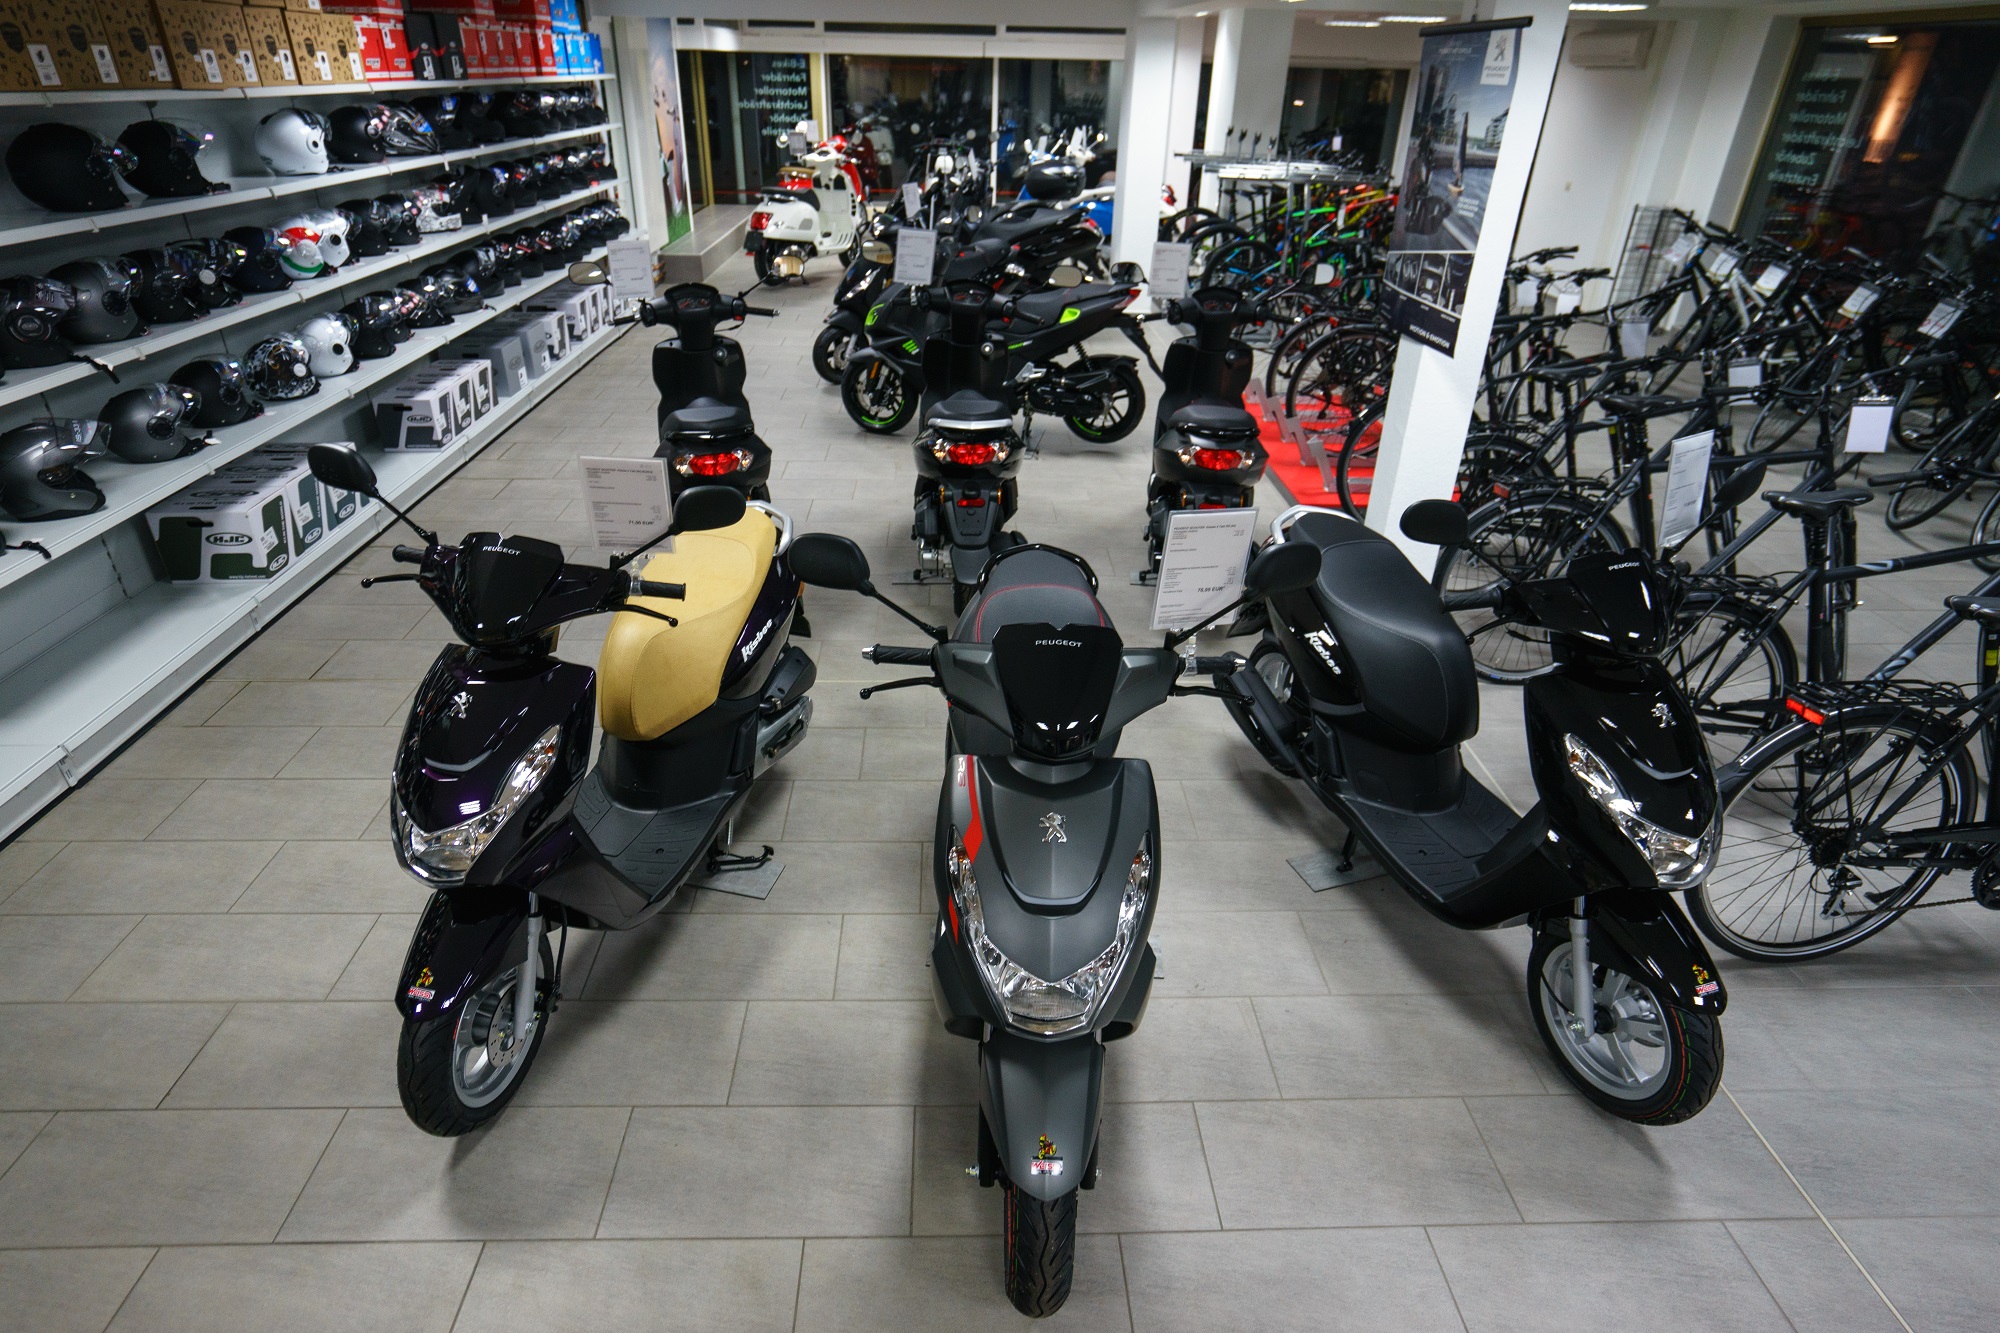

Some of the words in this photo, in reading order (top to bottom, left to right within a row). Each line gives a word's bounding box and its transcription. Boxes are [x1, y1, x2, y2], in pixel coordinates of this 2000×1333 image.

[482, 546, 522, 556] PEUGEOT
[1608, 562, 1640, 571] PEUGEOT
[740, 618, 772, 663] Kisbee
[1035, 639, 1083, 648] PEUGEOT
[1304, 630, 1342, 675] Kisbee
